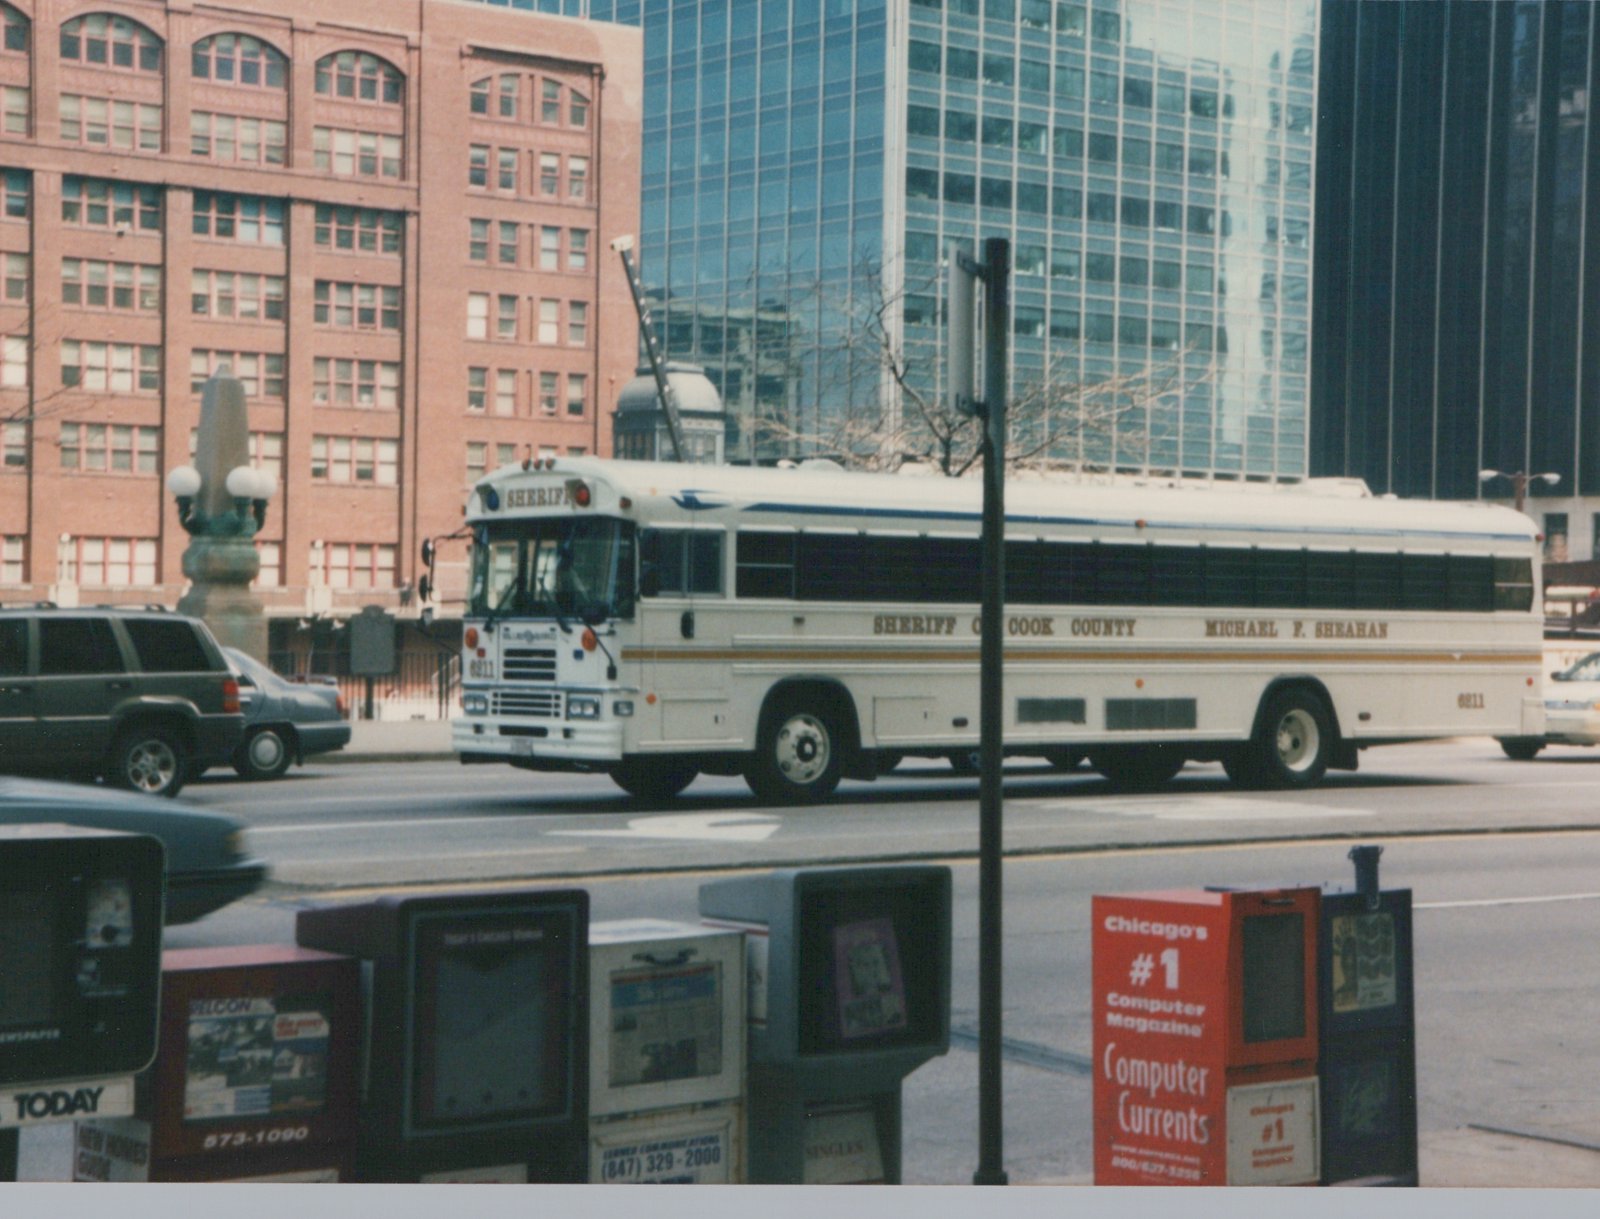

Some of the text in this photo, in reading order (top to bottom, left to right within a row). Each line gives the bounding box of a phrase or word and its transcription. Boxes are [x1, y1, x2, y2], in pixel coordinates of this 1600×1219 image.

[873, 615, 957, 636] SHERIFF
[1008, 616, 1055, 637] COOK
[1070, 617, 1137, 638] COUNTY
[1204, 620, 1278, 638] MICHAEL
[1314, 621, 1389, 640] SHEAHAN
[1104, 915, 1208, 941] Chicago's
[1128, 947, 1180, 990] #1
[1106, 992, 1206, 1017] Computer
[1106, 1012, 1203, 1039] Magazine
[1103, 1041, 1209, 1098] Computer
[13, 1085, 105, 1121] TODAY
[1118, 1089, 1210, 1145] Currents
[203, 1126, 310, 1149] 573-1090
[601, 1157, 642, 1183] (847)
